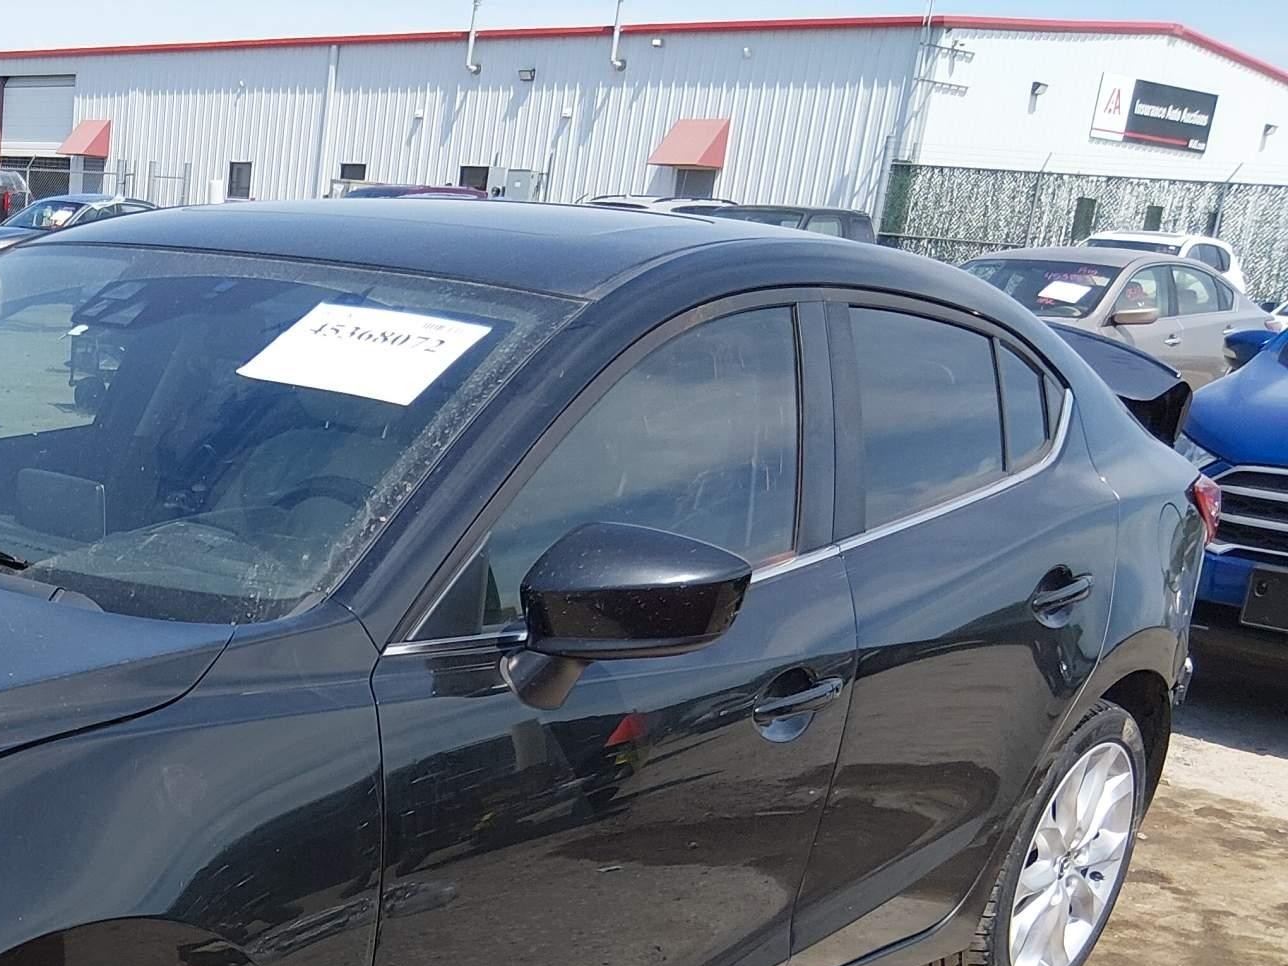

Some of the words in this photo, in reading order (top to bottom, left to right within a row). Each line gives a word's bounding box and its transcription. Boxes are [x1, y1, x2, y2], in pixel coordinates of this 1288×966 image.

[1133, 99, 1168, 120] Insurance
[1166, 104, 1182, 122] Auto
[1180, 107, 1210, 127] Auctions
[309, 321, 446, 353] 45368072
